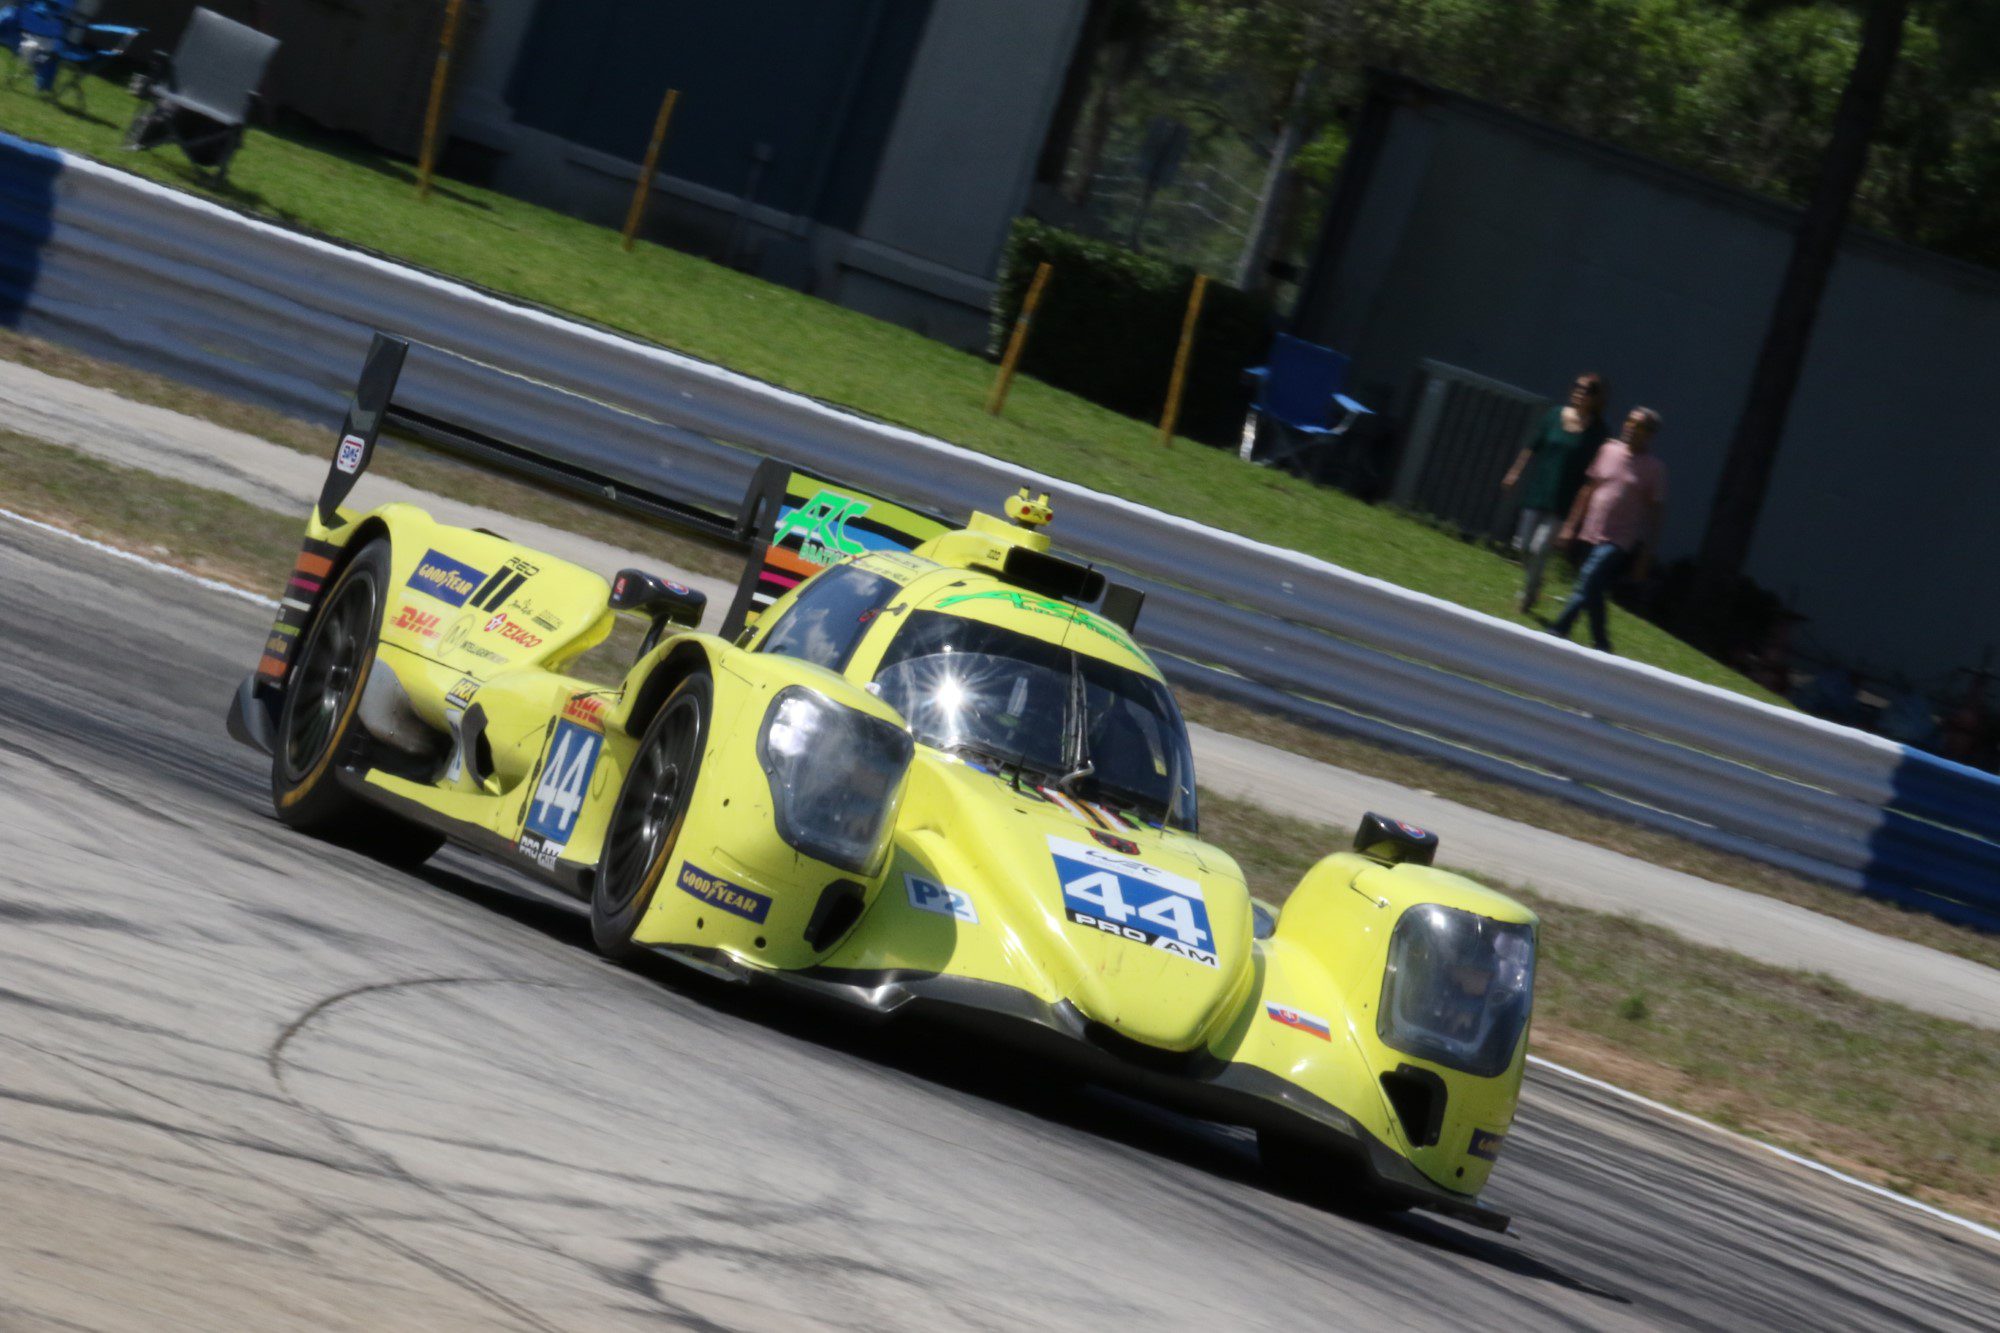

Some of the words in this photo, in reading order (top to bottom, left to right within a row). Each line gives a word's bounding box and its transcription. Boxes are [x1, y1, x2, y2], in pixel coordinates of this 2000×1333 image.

[418, 563, 474, 596] GOODYEAR
[507, 556, 540, 577] RED
[499, 621, 543, 648] TEXACO
[535, 729, 595, 831] 44
[519, 835, 541, 860] PRO
[682, 869, 757, 914] GOODYEAR
[911, 878, 970, 917] P2
[1065, 871, 1208, 947] 44
[1074, 913, 1148, 943] PRO
[1164, 942, 1216, 967] AM
